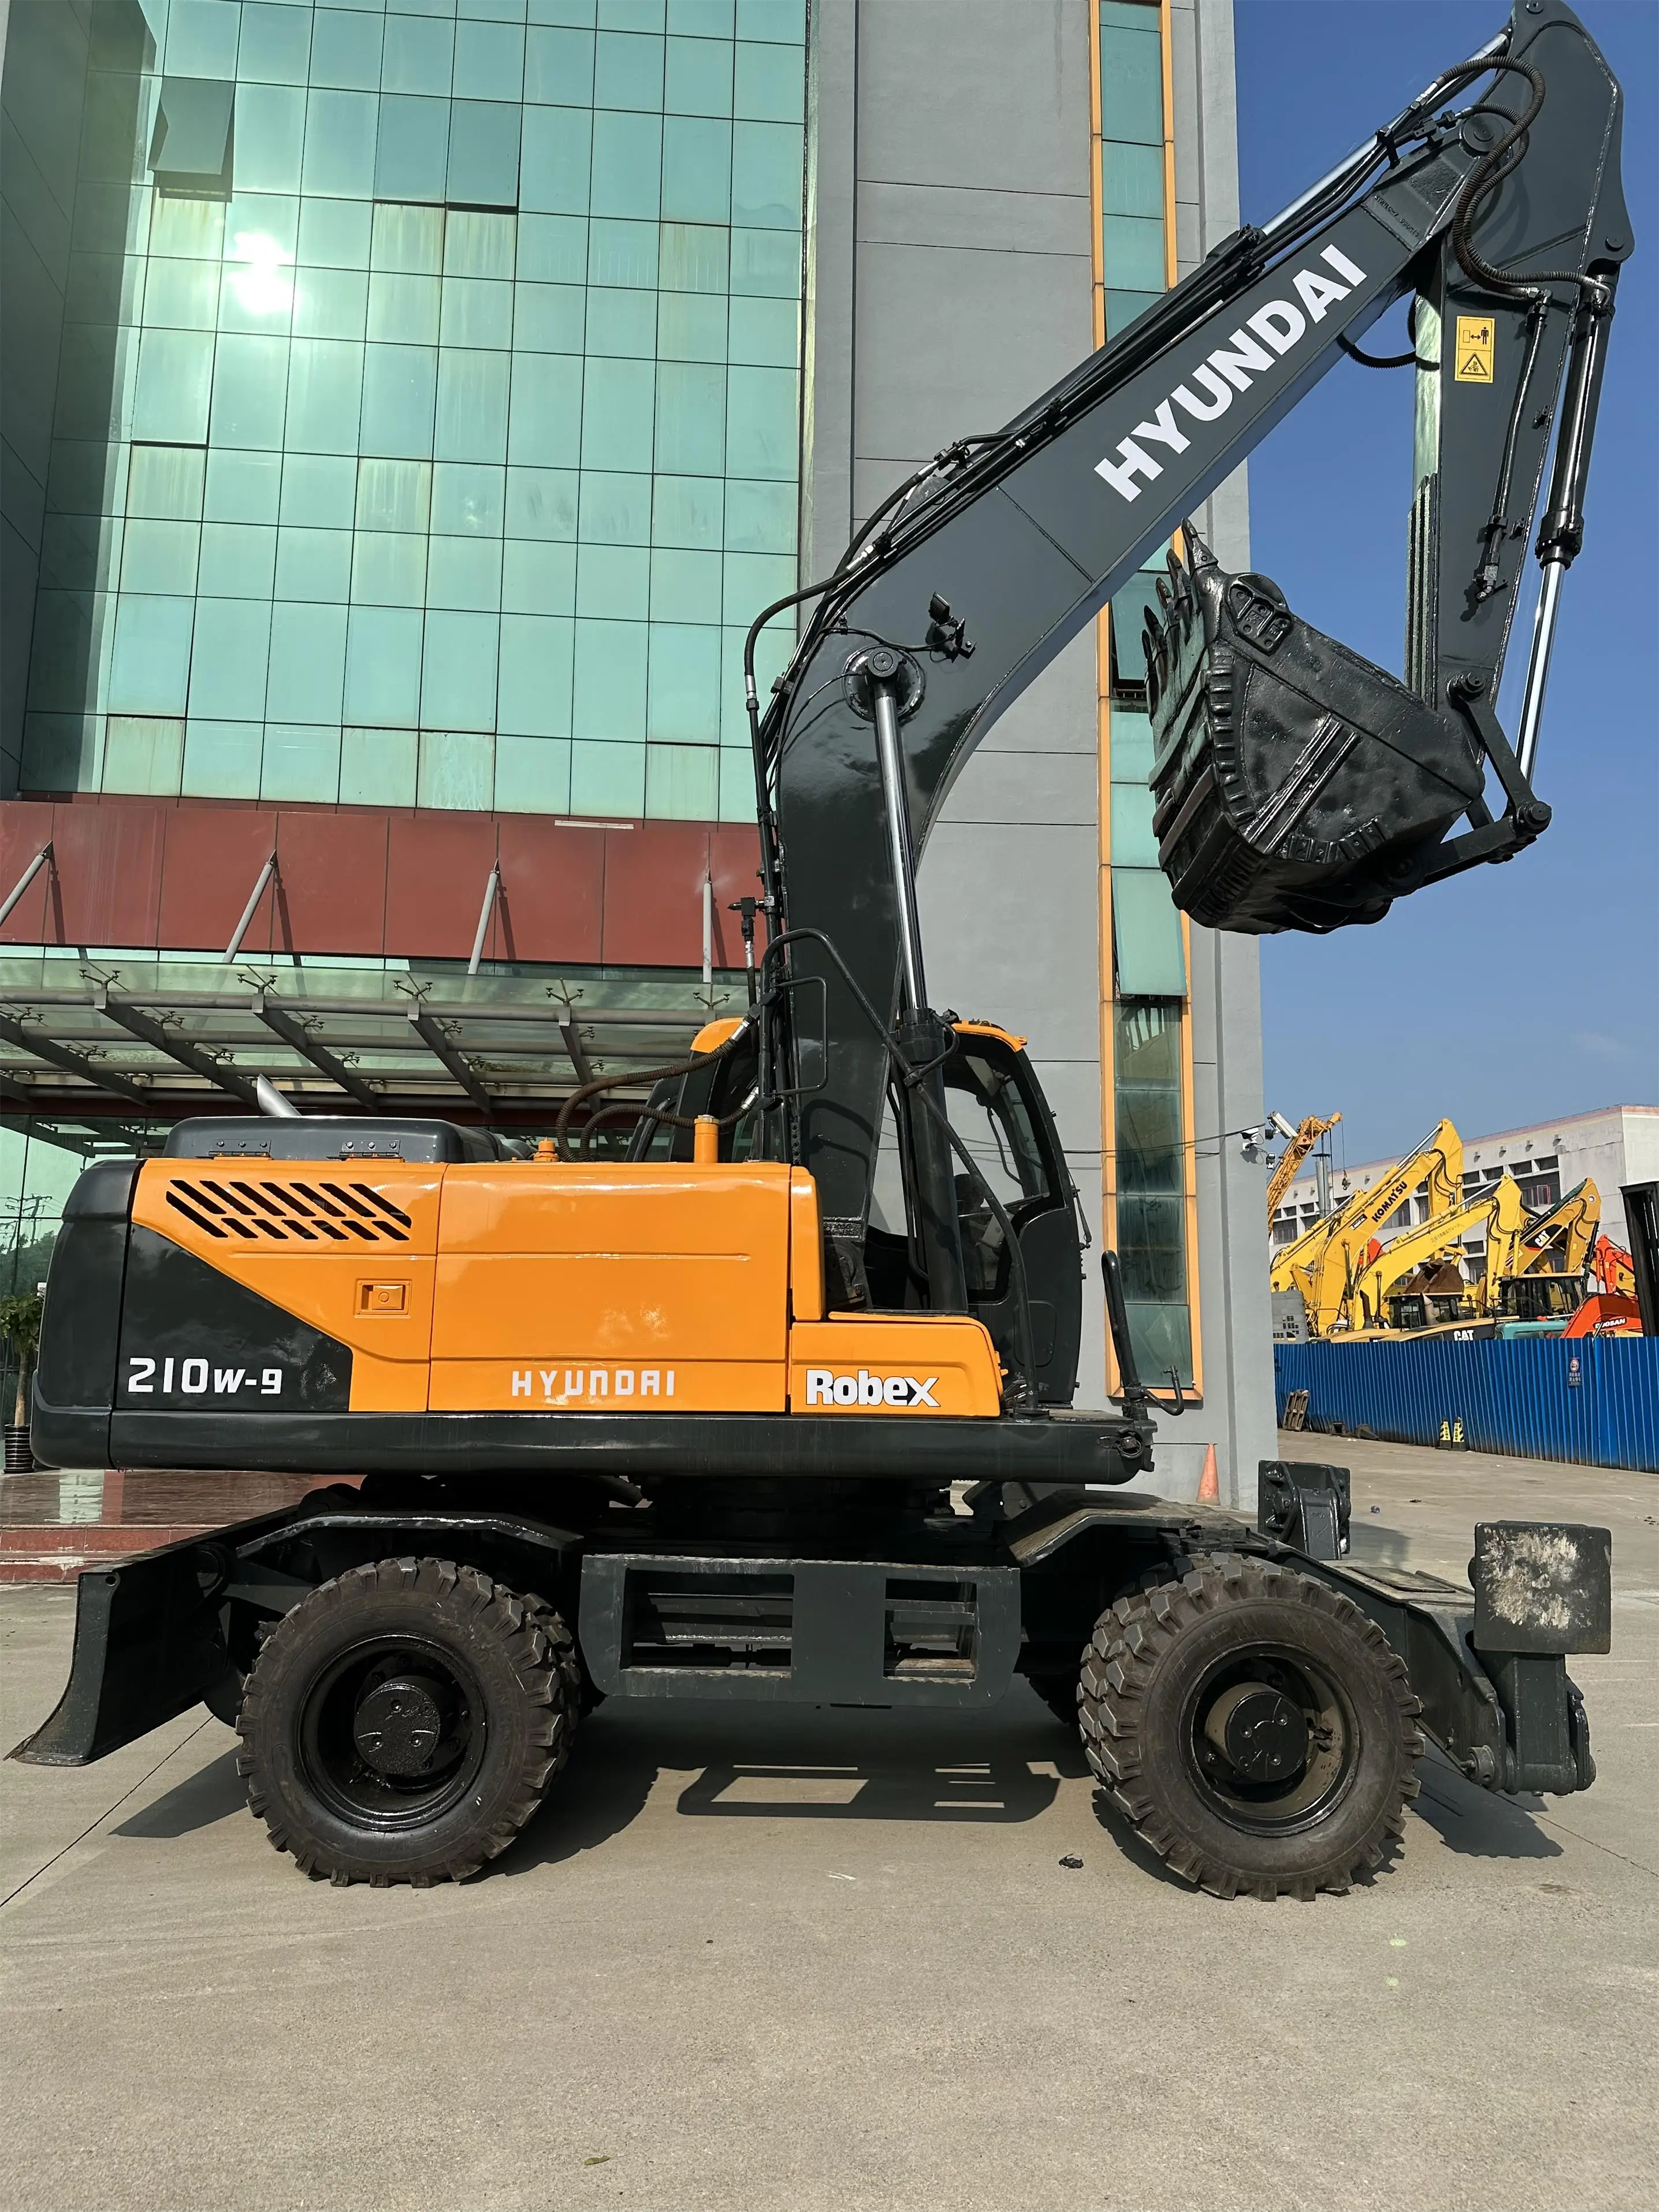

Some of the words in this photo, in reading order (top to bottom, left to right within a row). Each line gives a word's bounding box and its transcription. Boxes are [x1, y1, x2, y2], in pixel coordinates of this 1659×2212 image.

[1093, 243, 1368, 503] HYUNDAI
[1371, 1181, 1408, 1223] KOMATSU
[1534, 1230, 1550, 1247] CAT
[1453, 1329, 1474, 1341] CAT
[512, 1370, 675, 1397] HYUNDAI
[806, 1369, 941, 1407] Robex
